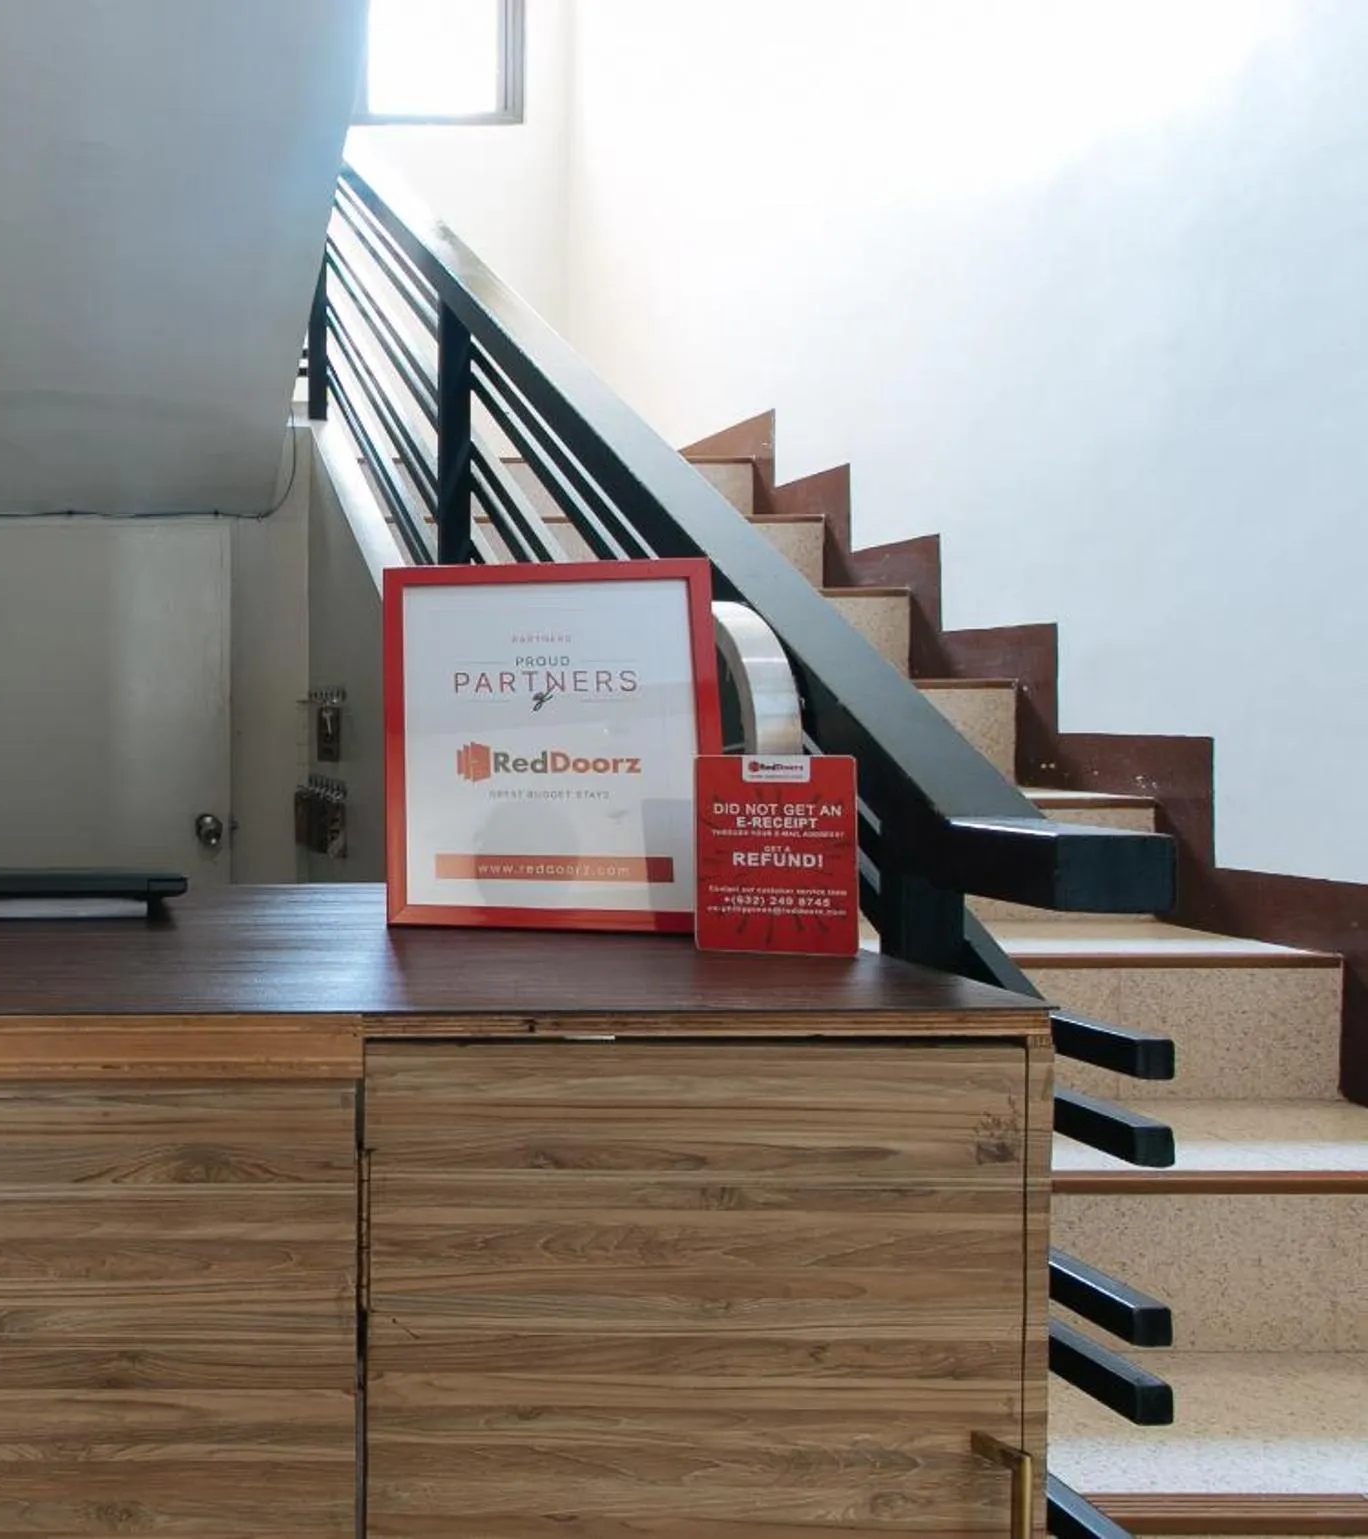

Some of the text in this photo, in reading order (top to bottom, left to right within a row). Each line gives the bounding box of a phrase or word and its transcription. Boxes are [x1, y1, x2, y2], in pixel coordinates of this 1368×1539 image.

[515, 656, 570, 667] PROUD
[454, 670, 638, 694] PARTNERS
[493, 751, 642, 775] RedDoorz
[713, 803, 843, 816] DID NOT GET AN
[736, 817, 819, 829] E-RECEIPT
[732, 852, 823, 868] REFUND!
[477, 863, 631, 877] www.reddoorz.com
